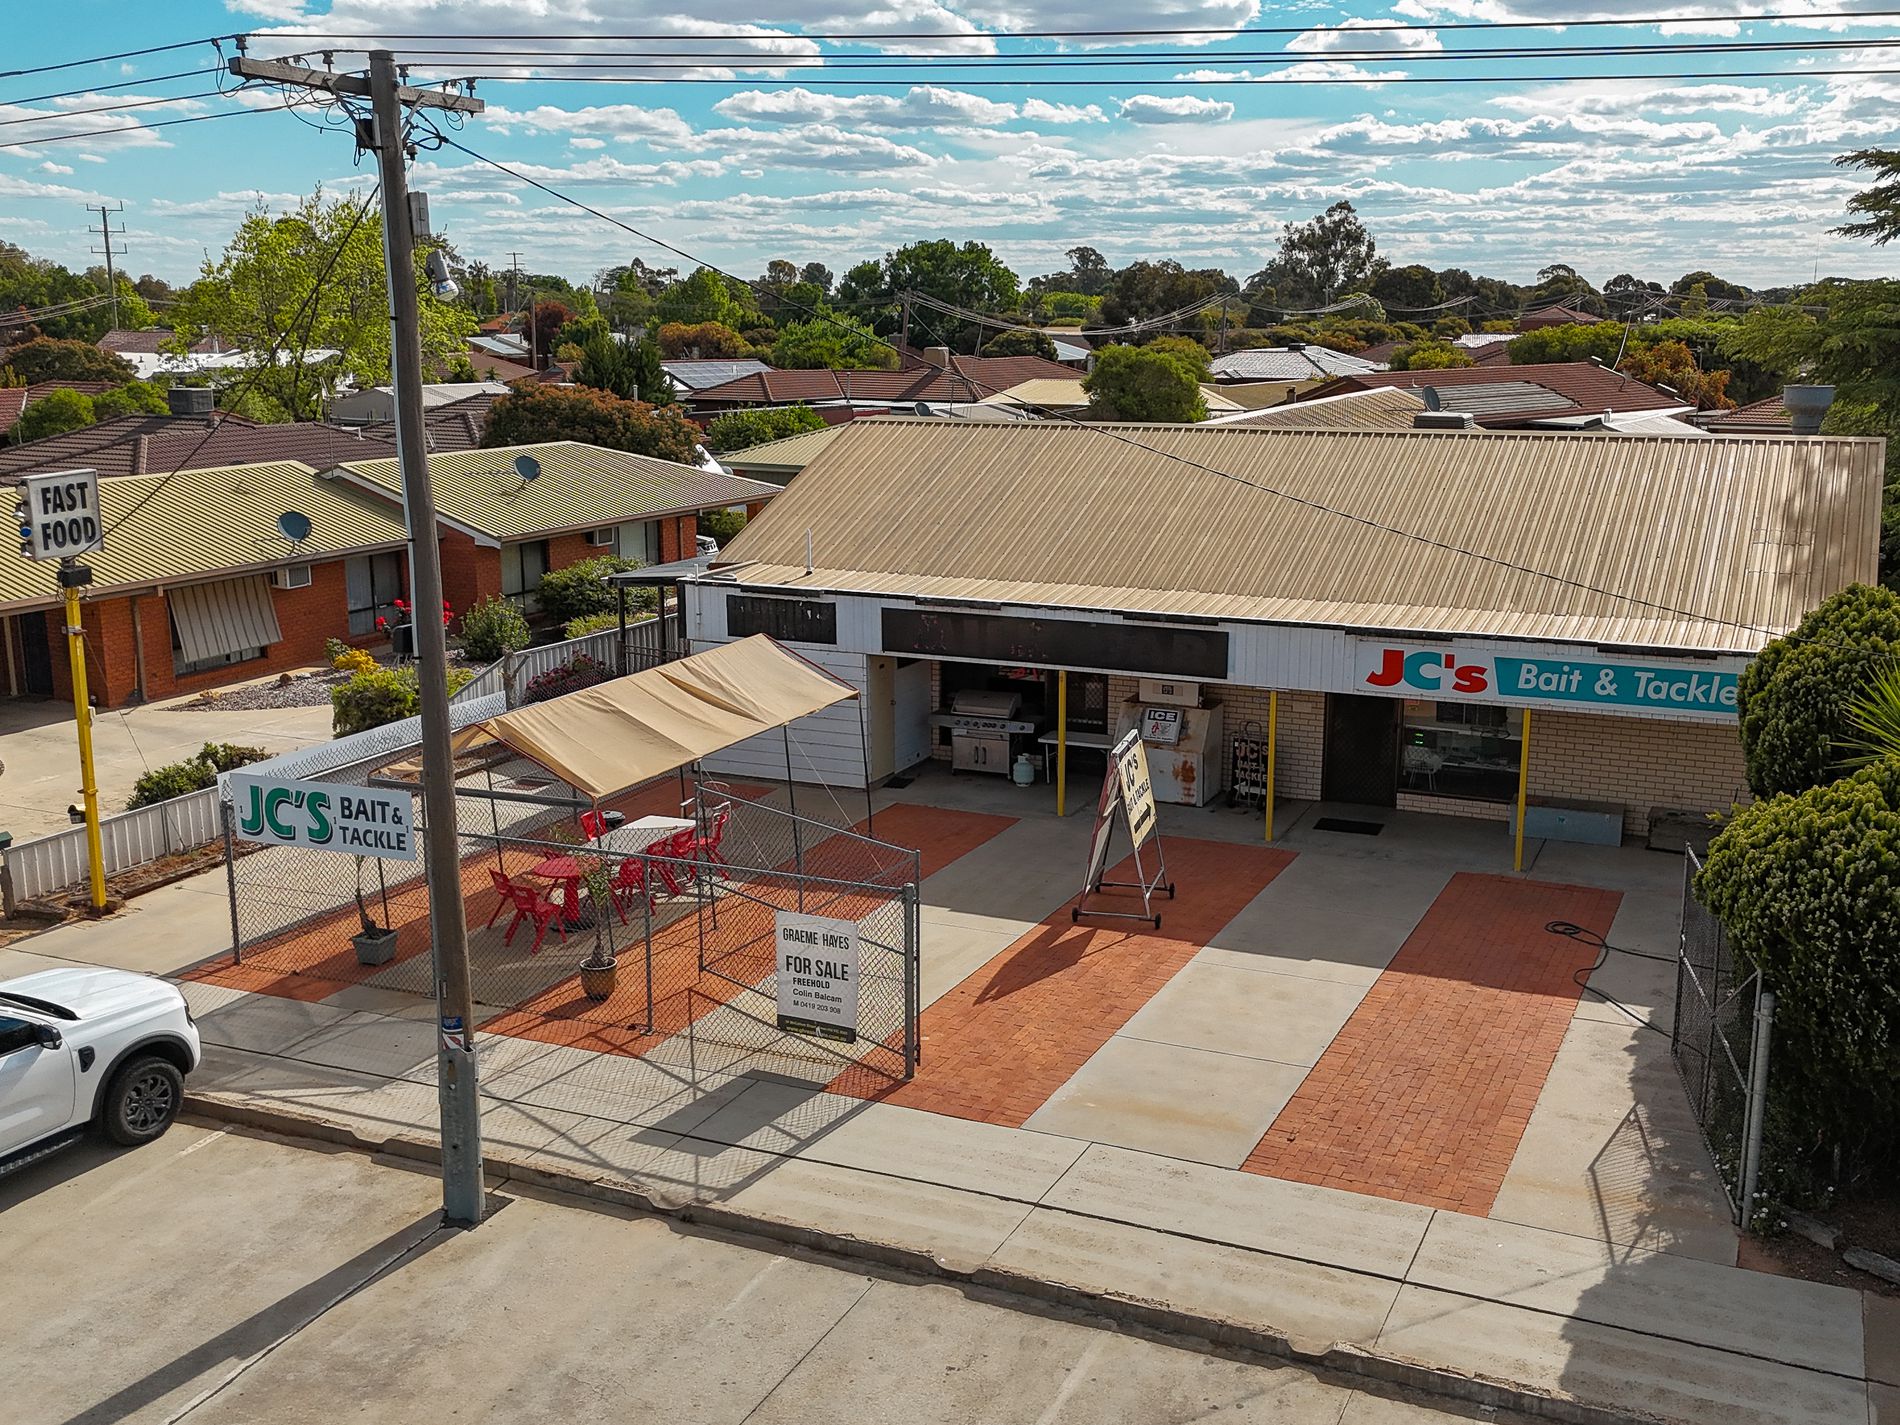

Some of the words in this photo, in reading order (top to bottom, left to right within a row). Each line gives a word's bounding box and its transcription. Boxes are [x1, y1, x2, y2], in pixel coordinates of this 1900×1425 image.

[41, 482, 88, 515] FAST
[41, 517, 97, 550] FOOD
[1366, 649, 1488, 694] JC's
[1517, 664, 1582, 693] Bait
[1594, 668, 1618, 697] &
[1635, 671, 1738, 705] Tackle
[1150, 711, 1176, 721] ICE
[240, 785, 334, 845] JC'S
[339, 796, 390, 824] BAIT
[391, 806, 403, 825] &
[339, 826, 407, 852] TACKLE
[783, 927, 819, 946] GRAEME
[822, 933, 850, 950] HAYES
[785, 954, 812, 976] FOR
[815, 959, 850, 982] SALE
[792, 977, 830, 990] FREEHOLD
[792, 988, 813, 999] Colin
[816, 1004, 829, 1013] 203
